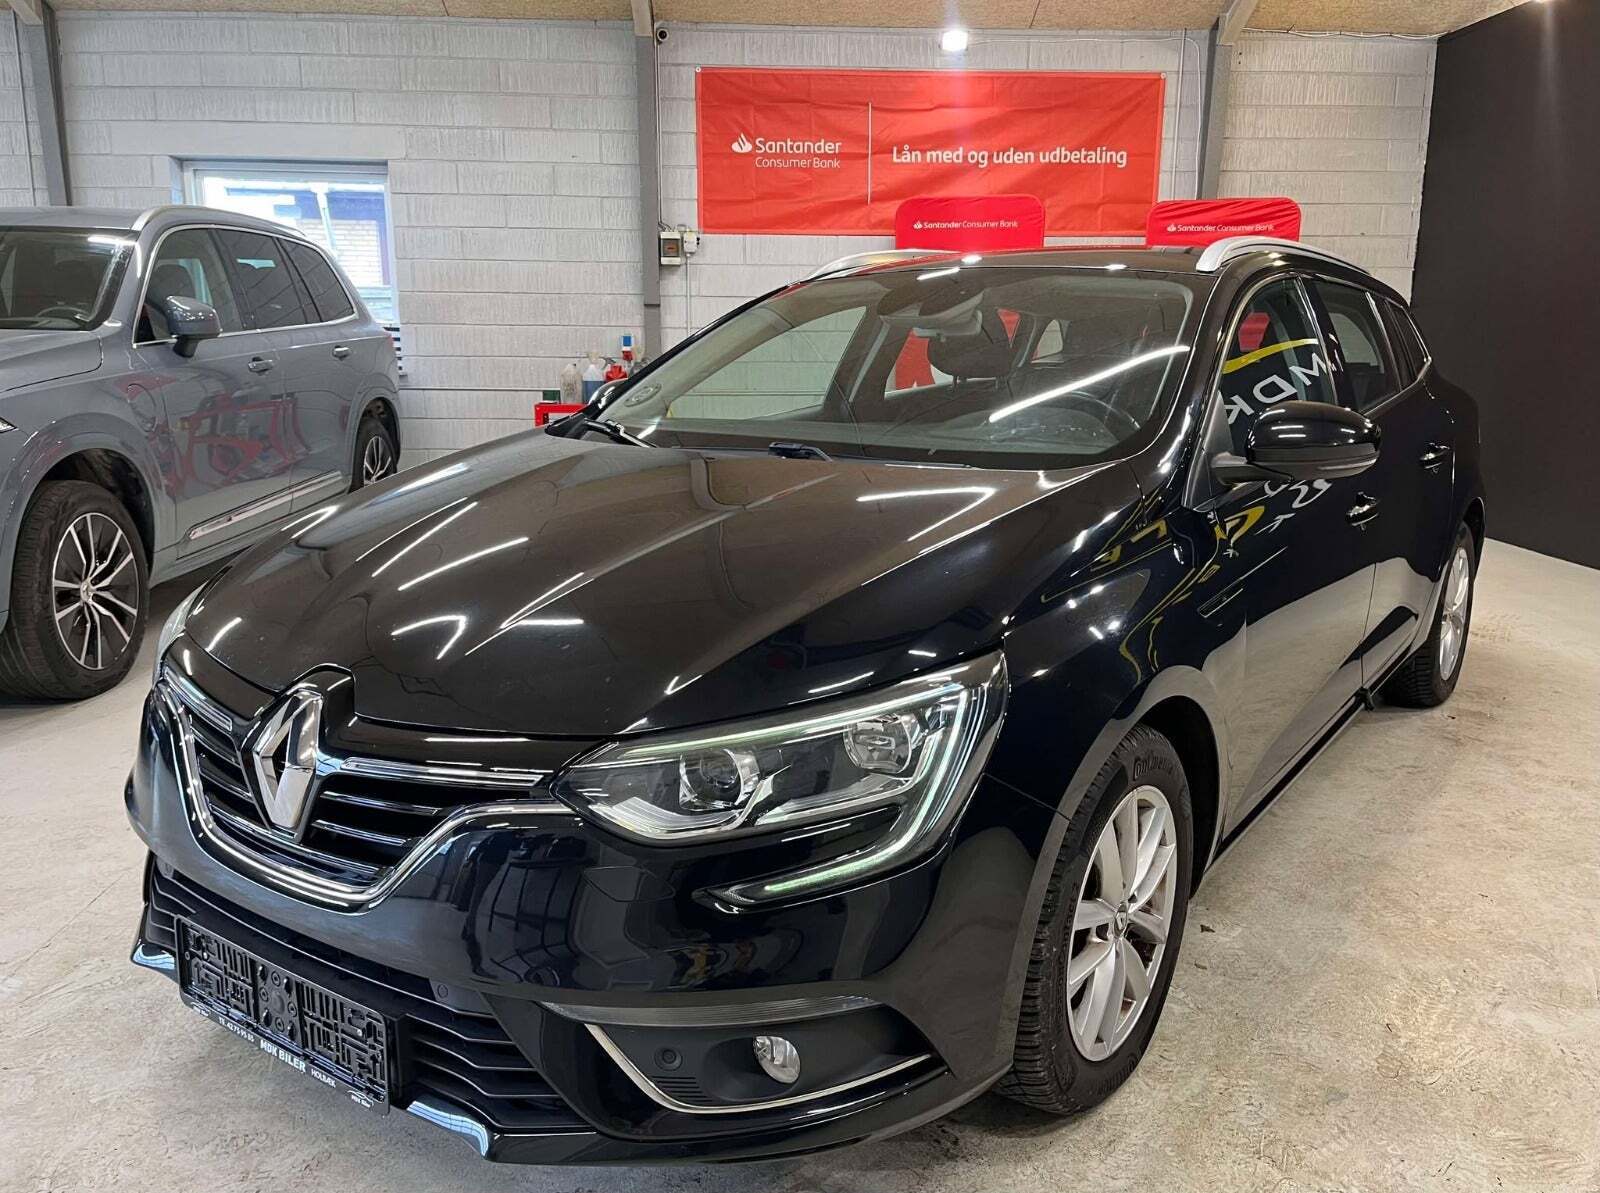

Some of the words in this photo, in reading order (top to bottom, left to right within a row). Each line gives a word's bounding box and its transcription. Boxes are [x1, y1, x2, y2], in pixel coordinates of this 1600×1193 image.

[755, 137, 842, 154] Santander
[755, 156, 812, 169] Consumer
[813, 157, 841, 169] Bank
[892, 144, 922, 164] Lån
[926, 146, 963, 164] med
[967, 150, 989, 168] og
[992, 147, 1035, 164] uden
[1039, 146, 1128, 168] udbetaling
[923, 221, 962, 230] Santander
[962, 220, 999, 229] Consumer
[999, 219, 1018, 229] Bank
[1177, 224, 1217, 232] Santander
[1216, 224, 1255, 232] Consumer
[1254, 223, 1274, 231] Bank
[278, 1049, 306, 1073] BILER
